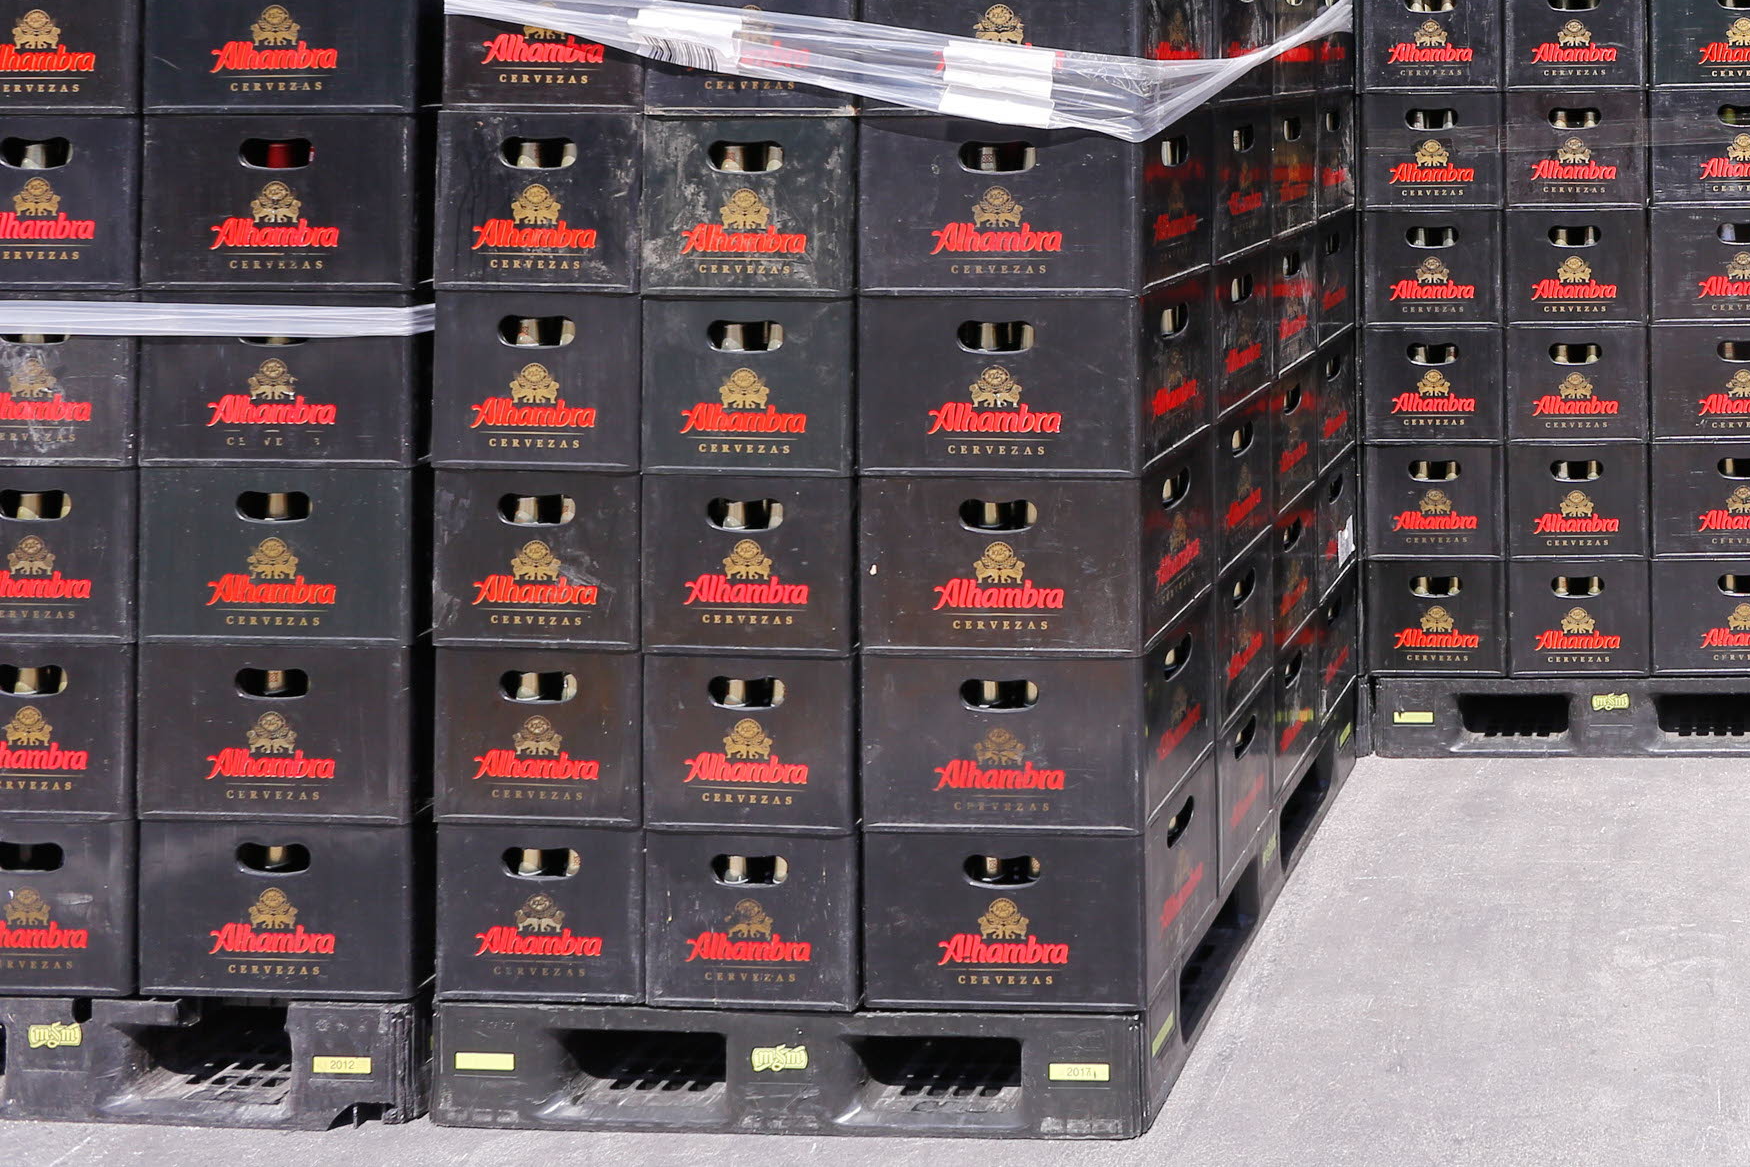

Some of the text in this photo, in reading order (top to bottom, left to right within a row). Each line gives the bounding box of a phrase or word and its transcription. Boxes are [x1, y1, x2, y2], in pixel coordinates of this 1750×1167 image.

[481, 27, 605, 64] Alhambra
[1388, 42, 1474, 63] Alhambra
[1531, 42, 1618, 63] Alhambra
[209, 40, 338, 73] Alhambra
[500, 72, 587, 84] CERVEZAS
[1544, 67, 1605, 75] CERVEZAS
[2, 84, 80, 94] ERVEZAS
[230, 83, 322, 92] CERVEZAS
[1388, 162, 1475, 183] Alhambra
[1530, 159, 1618, 180] Alhambra
[1402, 188, 1463, 196] CERVEZAS
[209, 217, 340, 249] Alhambra
[471, 218, 598, 249] Alhambra
[680, 223, 807, 254] Alhambra
[930, 222, 1063, 254] Alhambra
[2, 250, 80, 260] ERVEZAS
[491, 258, 583, 269] CERVEZAS
[1389, 279, 1476, 301] Alhambra
[1530, 279, 1618, 302] Alhambra
[1544, 304, 1605, 312] CERVEZAS
[206, 394, 338, 426] Alhambra
[469, 396, 597, 427] Alhambra
[1391, 392, 1477, 415] Alhambra
[1531, 394, 1620, 416] Alhambra
[679, 402, 808, 433] Alhambra
[927, 401, 1063, 434] Alhambra
[1404, 417, 1464, 425] CERVEZAS
[1546, 420, 1607, 428] CERVEZAS
[489, 436, 579, 448] CERVEZAS
[699, 441, 789, 453] CERVEZAS
[948, 443, 1044, 455] CERVEZAS
[1392, 510, 1479, 531] Alhambra
[1533, 512, 1620, 534] Alhambra
[205, 573, 337, 605] Alhambra
[471, 574, 599, 605] Alhambra
[682, 574, 810, 605] Alhambra
[931, 577, 1066, 610] Alhambra
[226, 613, 319, 625] CERVEZAS
[491, 614, 583, 624] CERVEZAS
[703, 612, 792, 624] CERVEZAS
[953, 617, 1047, 629] CERVEZAS
[1394, 628, 1480, 648] Alhambra
[1534, 629, 1622, 650] Alhambra
[1407, 653, 1467, 661] CERVEZAS
[1548, 654, 1609, 662] CERVEZAS
[204, 747, 336, 779] Alhambra
[472, 748, 601, 780] Alhambra
[682, 751, 810, 783] Alhambra
[933, 759, 1066, 791] Alhambra
[702, 793, 792, 805] CERVEZAS
[208, 922, 336, 954] Alhambra
[474, 925, 603, 956] Alhambra
[685, 931, 812, 962] Alhambra
[937, 933, 1070, 965] Alhambra
[228, 965, 319, 977] CERVEZAS
[958, 972, 1052, 984] CERVEZAS
[330, 1060, 355, 1070] 2012
